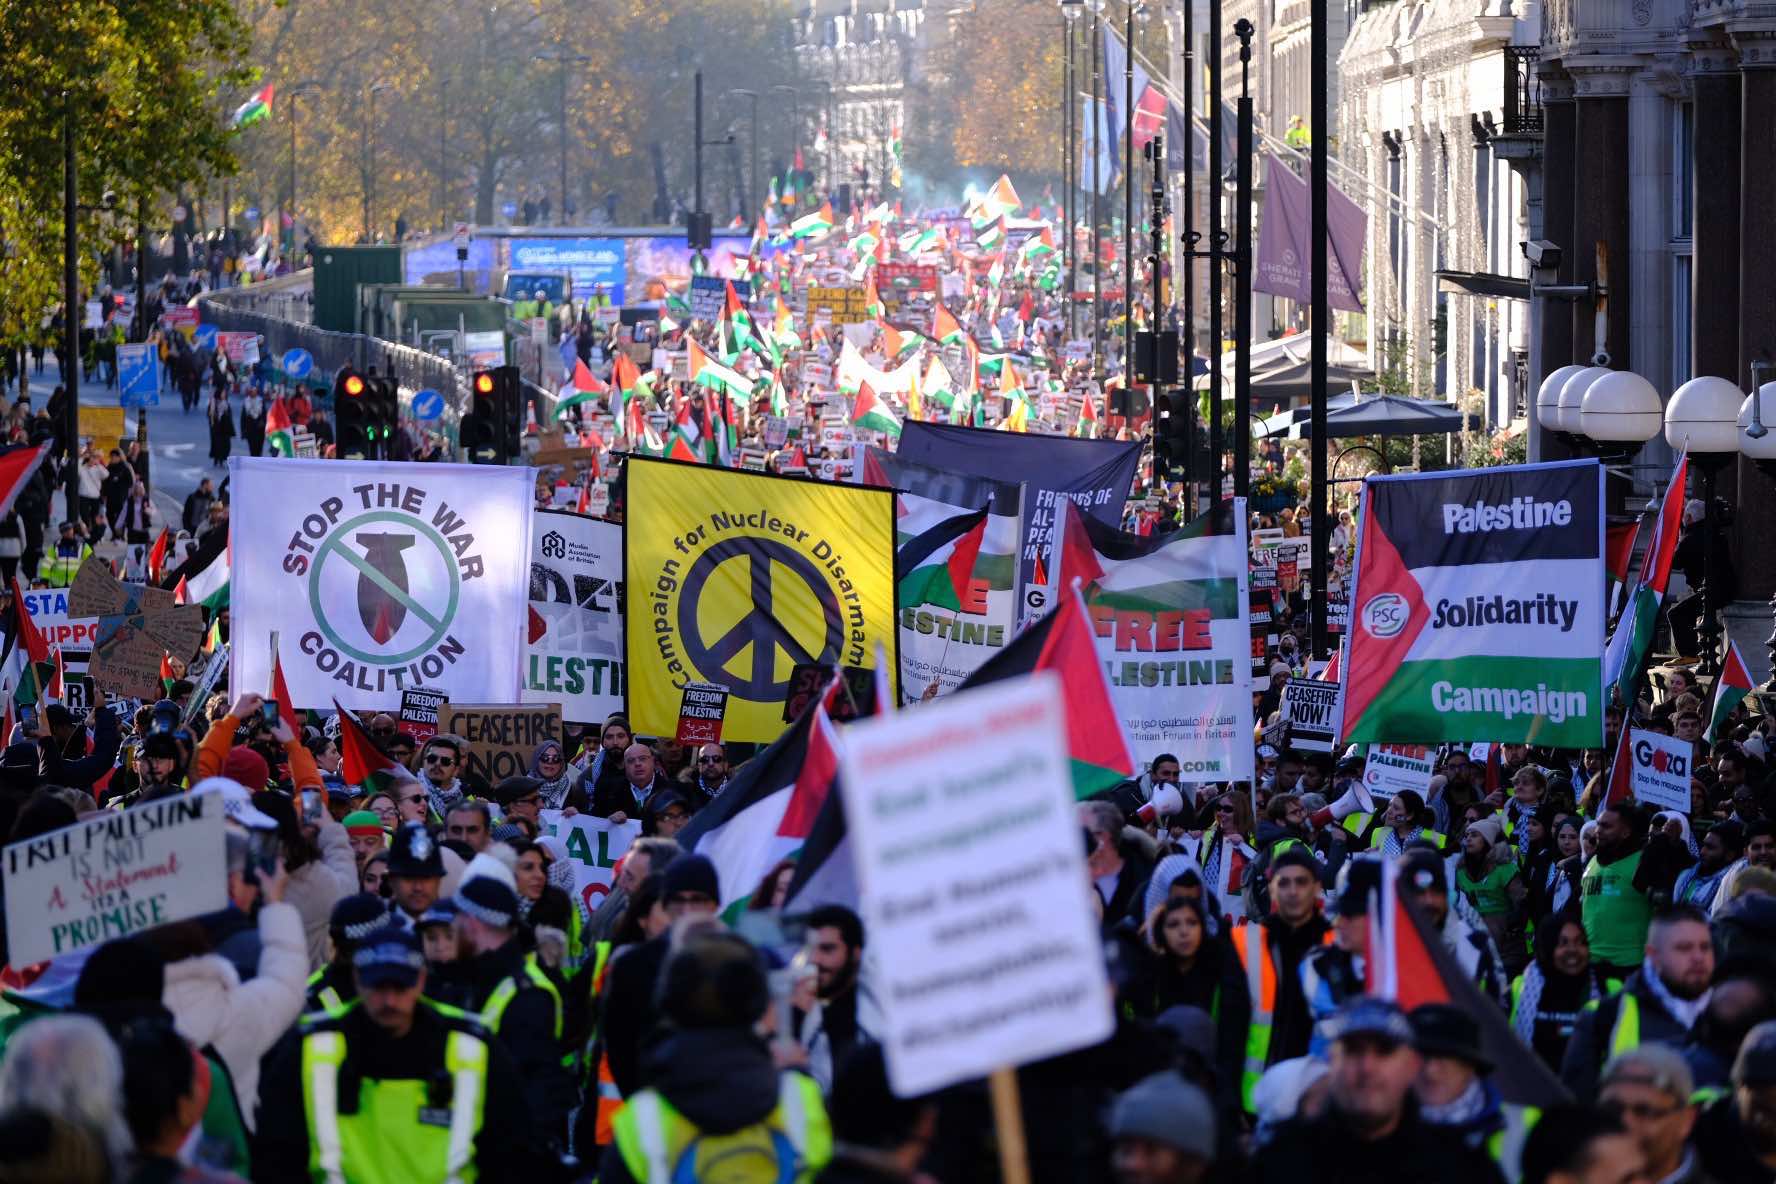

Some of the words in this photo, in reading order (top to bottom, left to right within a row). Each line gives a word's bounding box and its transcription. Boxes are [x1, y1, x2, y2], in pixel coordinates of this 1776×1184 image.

[1095, 488, 1113, 505] OF
[1443, 496, 1572, 534] Palestine
[283, 497, 344, 577] STOP
[353, 483, 426, 514] THE
[431, 501, 484, 581] WAR
[1028, 527, 1053, 543] PEA
[24, 594, 67, 616] STA
[650, 560, 691, 689] Campaign
[673, 524, 706, 554] for
[710, 510, 809, 543] Nuclear
[811, 540, 866, 666] Disarmam
[1327, 602, 1348, 613] ree
[1372, 607, 1400, 623] PSC
[1433, 592, 1578, 632] Solidarity
[902, 607, 1005, 648] ESTINE
[299, 631, 466, 692] COALITION
[406, 693, 445, 708] FREEDOM
[686, 691, 723, 703] FREEDOM
[1286, 686, 1338, 706] CEASEFIRE
[1432, 680, 1587, 724] Campaign
[402, 708, 438, 723] PALESTIN
[681, 706, 722, 719] PALESTINE
[451, 712, 560, 746] CEASEFIRE
[1205, 728, 1237, 739] Britain
[1370, 753, 1430, 774] PALESTINE
[1638, 773, 1650, 784] Stop
[1650, 777, 1660, 786] the
[10, 831, 70, 875] FREE
[71, 853, 91, 880] IS
[104, 837, 146, 870] NOT
[50, 892, 166, 953] PROMISE
